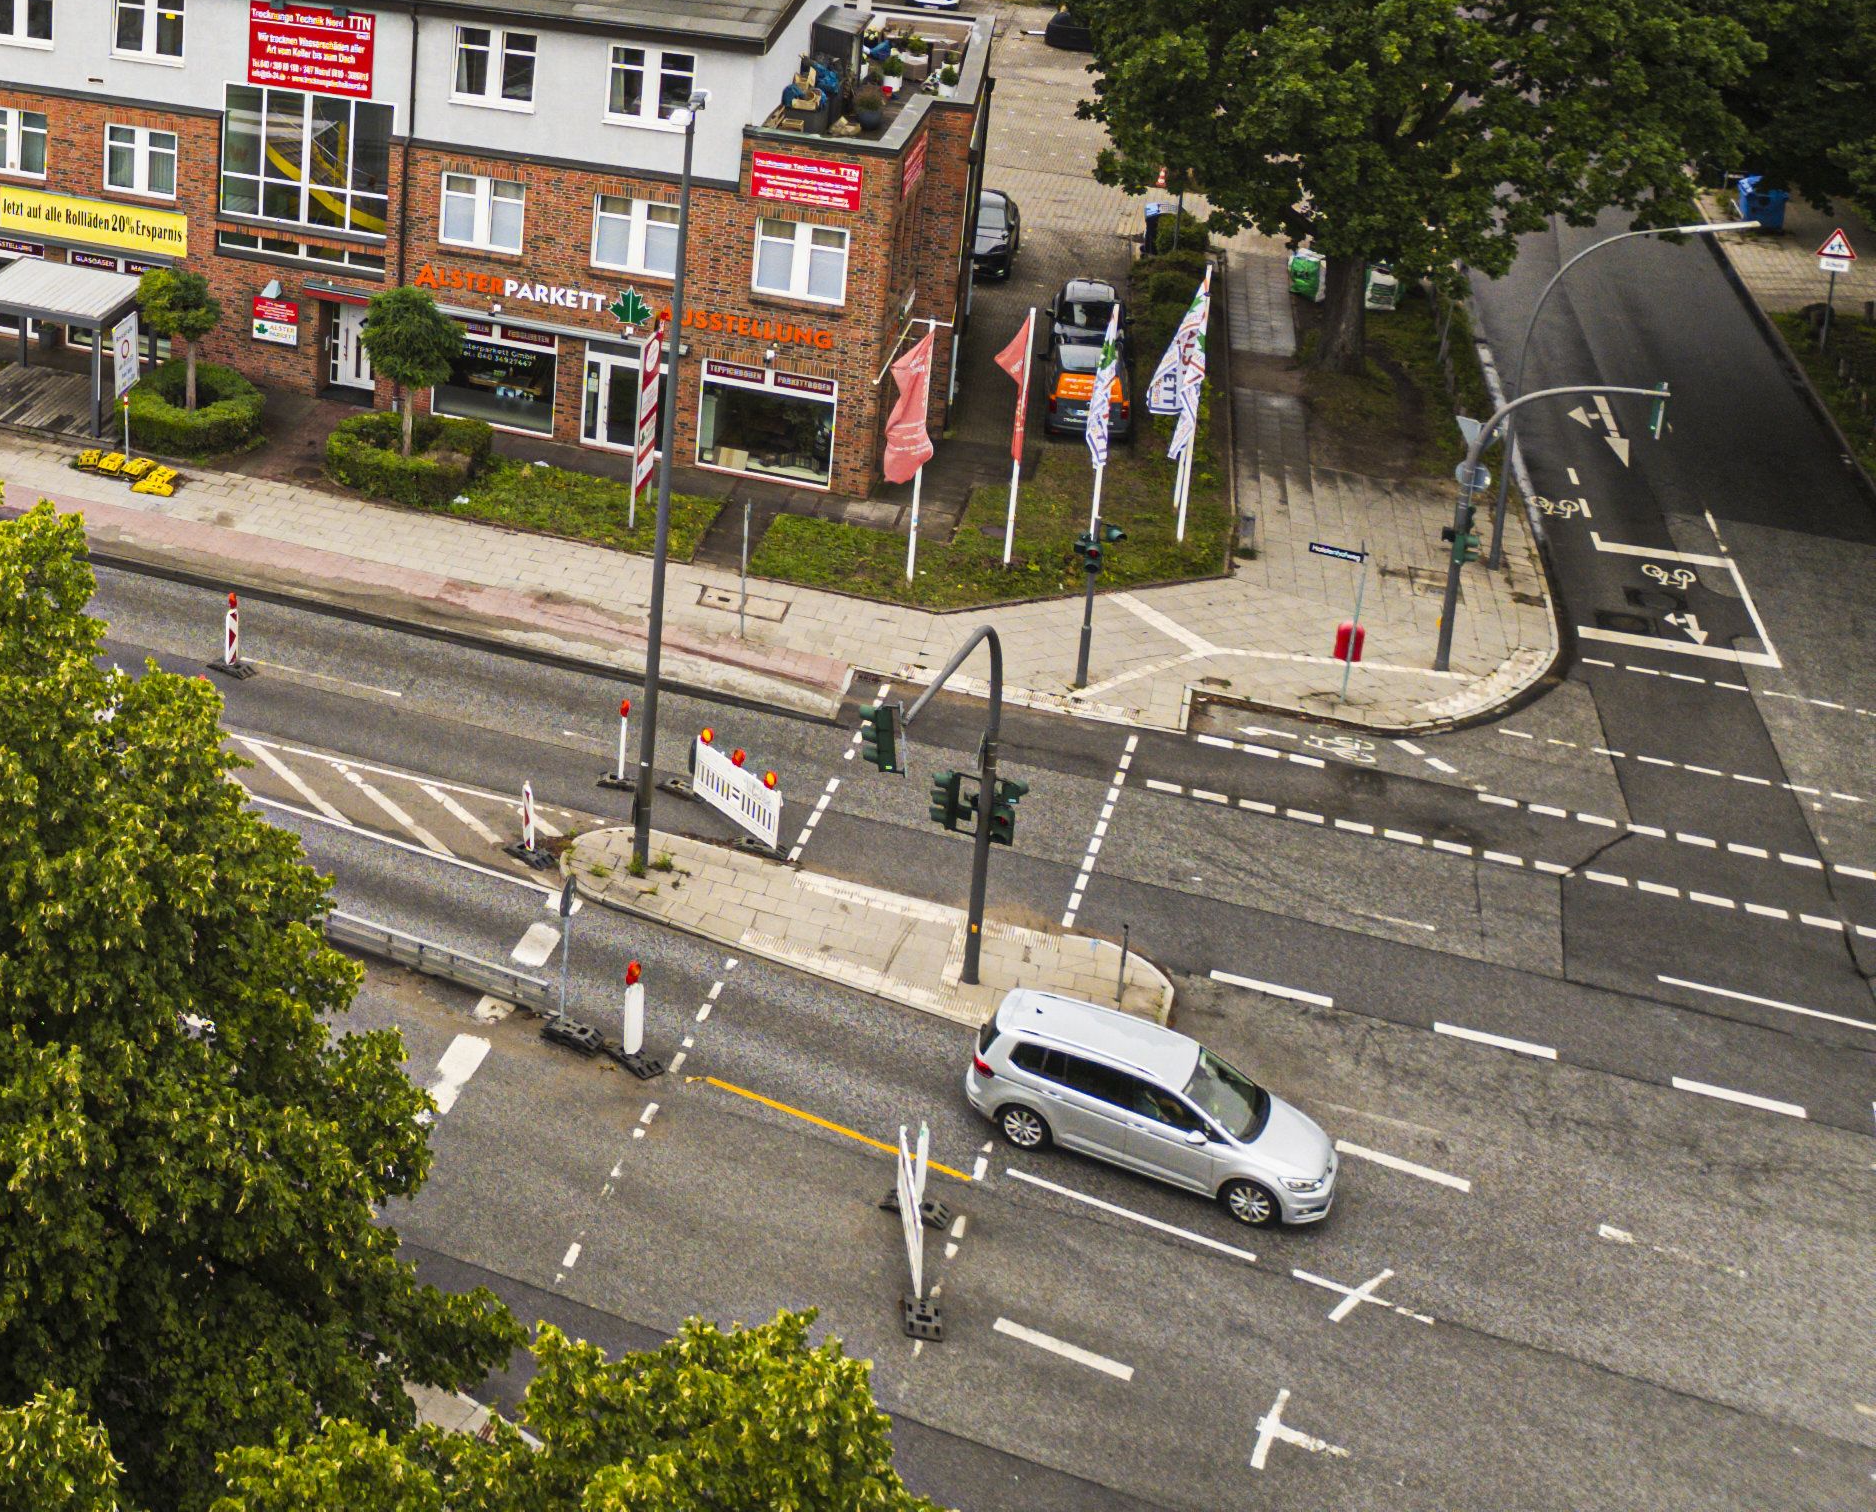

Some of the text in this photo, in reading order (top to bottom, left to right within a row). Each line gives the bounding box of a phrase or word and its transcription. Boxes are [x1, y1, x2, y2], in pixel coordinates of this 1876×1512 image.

[348, 15, 372, 31] TTN
[3, 198, 23, 217] Jetzt
[26, 200, 42, 220] auf
[45, 203, 62, 223] alle
[135, 219, 183, 242] Ersparnis
